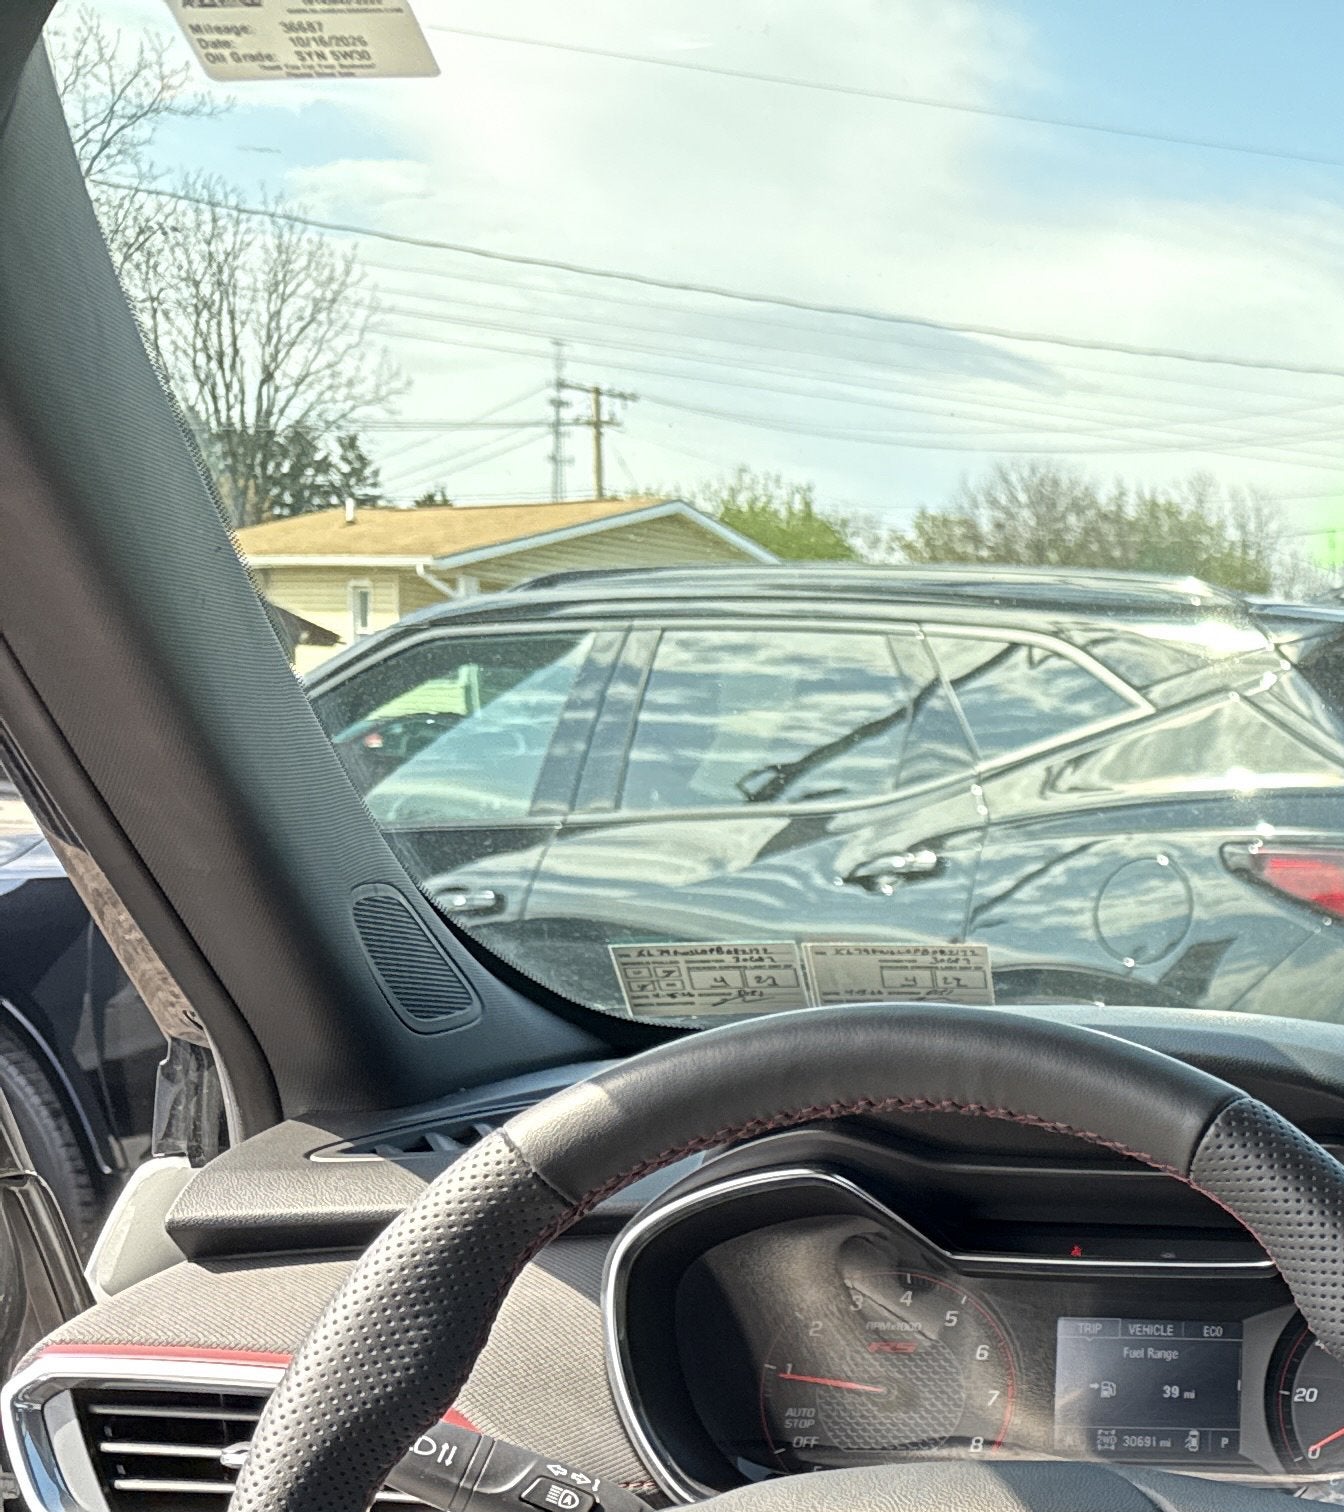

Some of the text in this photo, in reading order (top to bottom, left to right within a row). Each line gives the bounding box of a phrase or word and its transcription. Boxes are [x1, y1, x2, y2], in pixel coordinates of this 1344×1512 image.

[900, 1290, 913, 1307] 4
[943, 1310, 960, 1327] 5
[808, 1320, 824, 1337] 2
[1078, 1322, 1223, 1338] TRIP VEHICLE ECO
[975, 1344, 991, 1361] 6
[1123, 1347, 1180, 1361] Fuel Range
[987, 1389, 1000, 1407] 7
[1163, 1385, 1180, 1400] 39
[1294, 1387, 1319, 1403] 20
[785, 1407, 817, 1419] AUTO
[785, 1418, 816, 1430] STOP
[792, 1435, 820, 1449] OFF
[969, 1436, 985, 1453] 8
[1221, 1437, 1229, 1449] P
